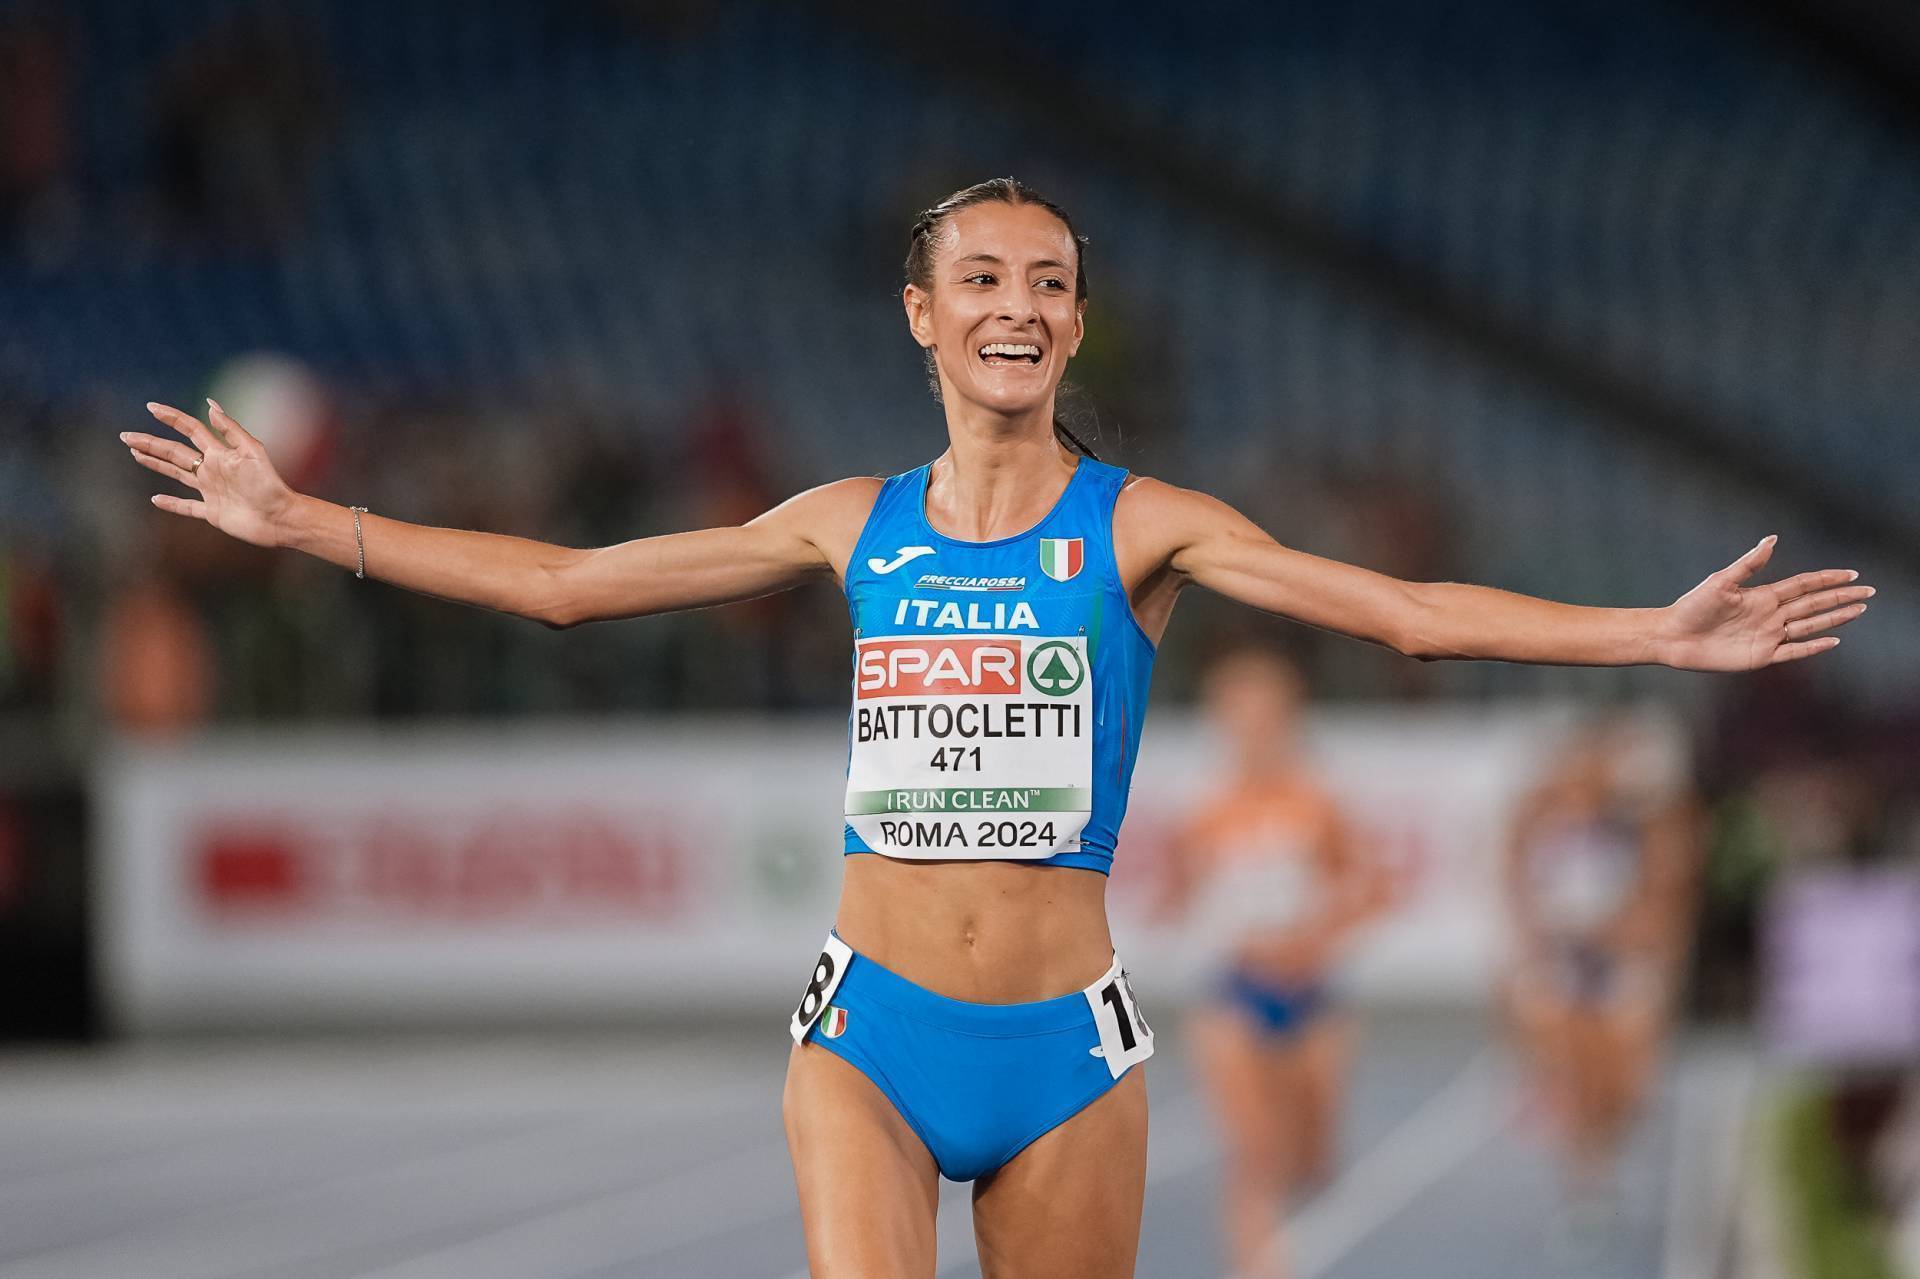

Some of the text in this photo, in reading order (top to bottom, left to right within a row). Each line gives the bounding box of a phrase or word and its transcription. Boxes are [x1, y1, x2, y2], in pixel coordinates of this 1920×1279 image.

[917, 574, 1027, 588] FRECCIAROSSA
[894, 599, 1040, 630] ITALIA
[860, 646, 1016, 691] SPAR
[858, 703, 1081, 743] BATTOCLETTI
[930, 746, 982, 772] 471
[887, 792, 892, 810] I
[896, 790, 946, 810] RUN
[880, 821, 1057, 847] ROMA 2024
[799, 951, 835, 1027] 8
